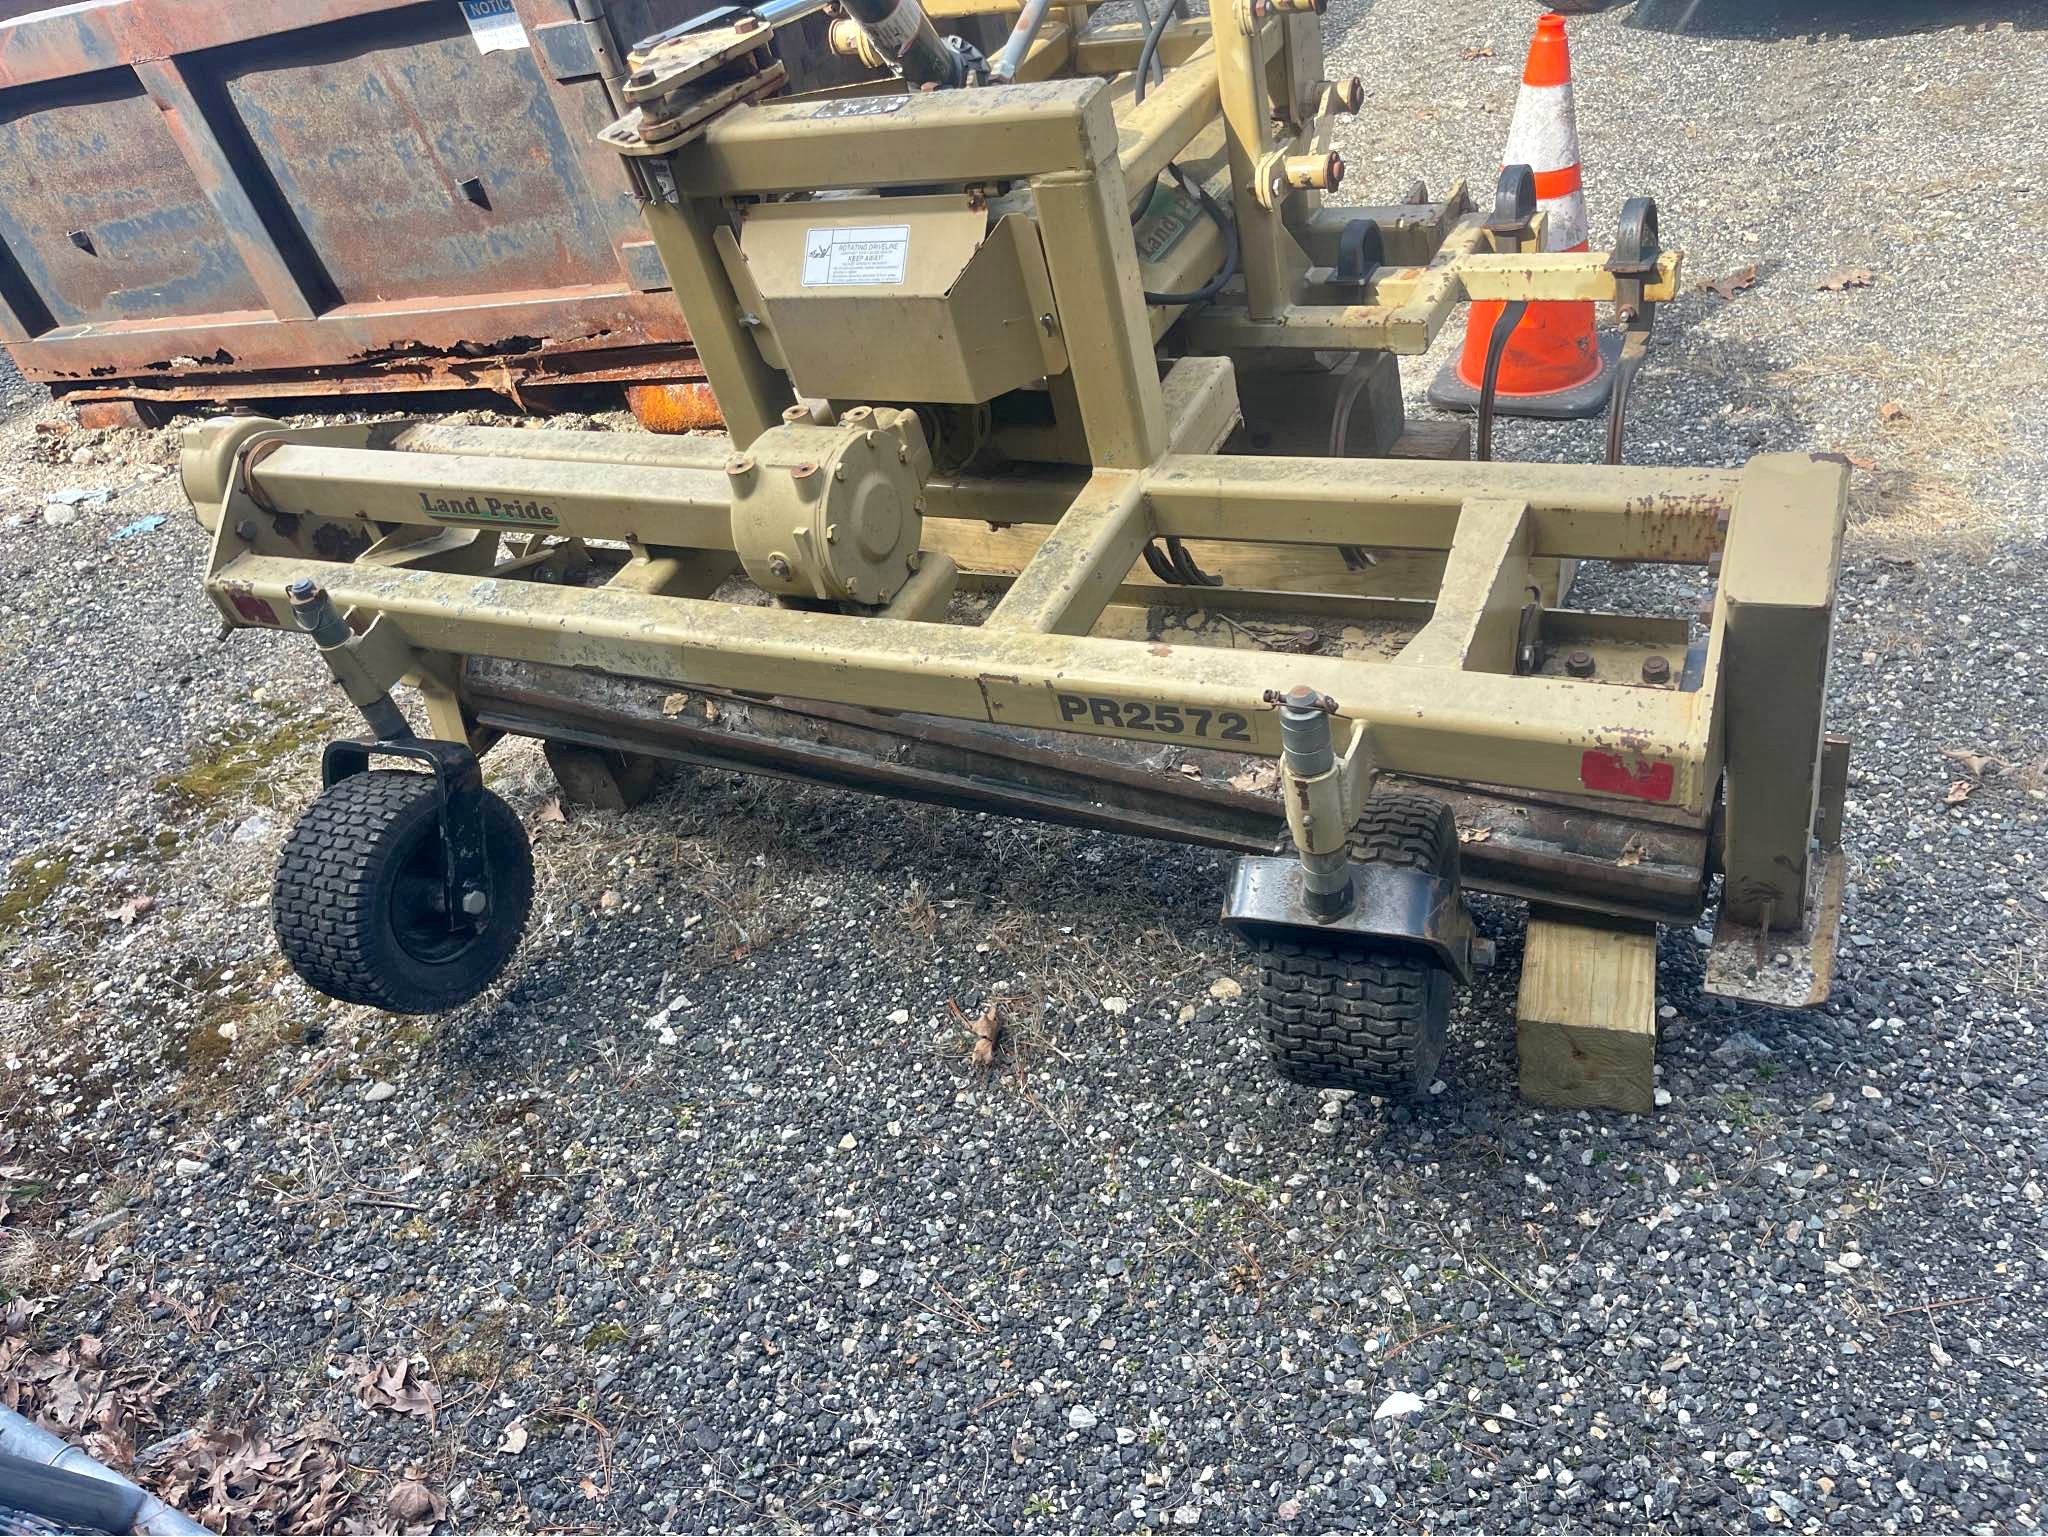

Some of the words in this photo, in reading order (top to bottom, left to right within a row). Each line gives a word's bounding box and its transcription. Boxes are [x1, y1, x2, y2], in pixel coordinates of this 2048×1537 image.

[469, 0, 511, 16] NOTIC
[418, 492, 480, 514] Land
[484, 497, 555, 520] Pride
[1056, 694, 1251, 742] PR2572
